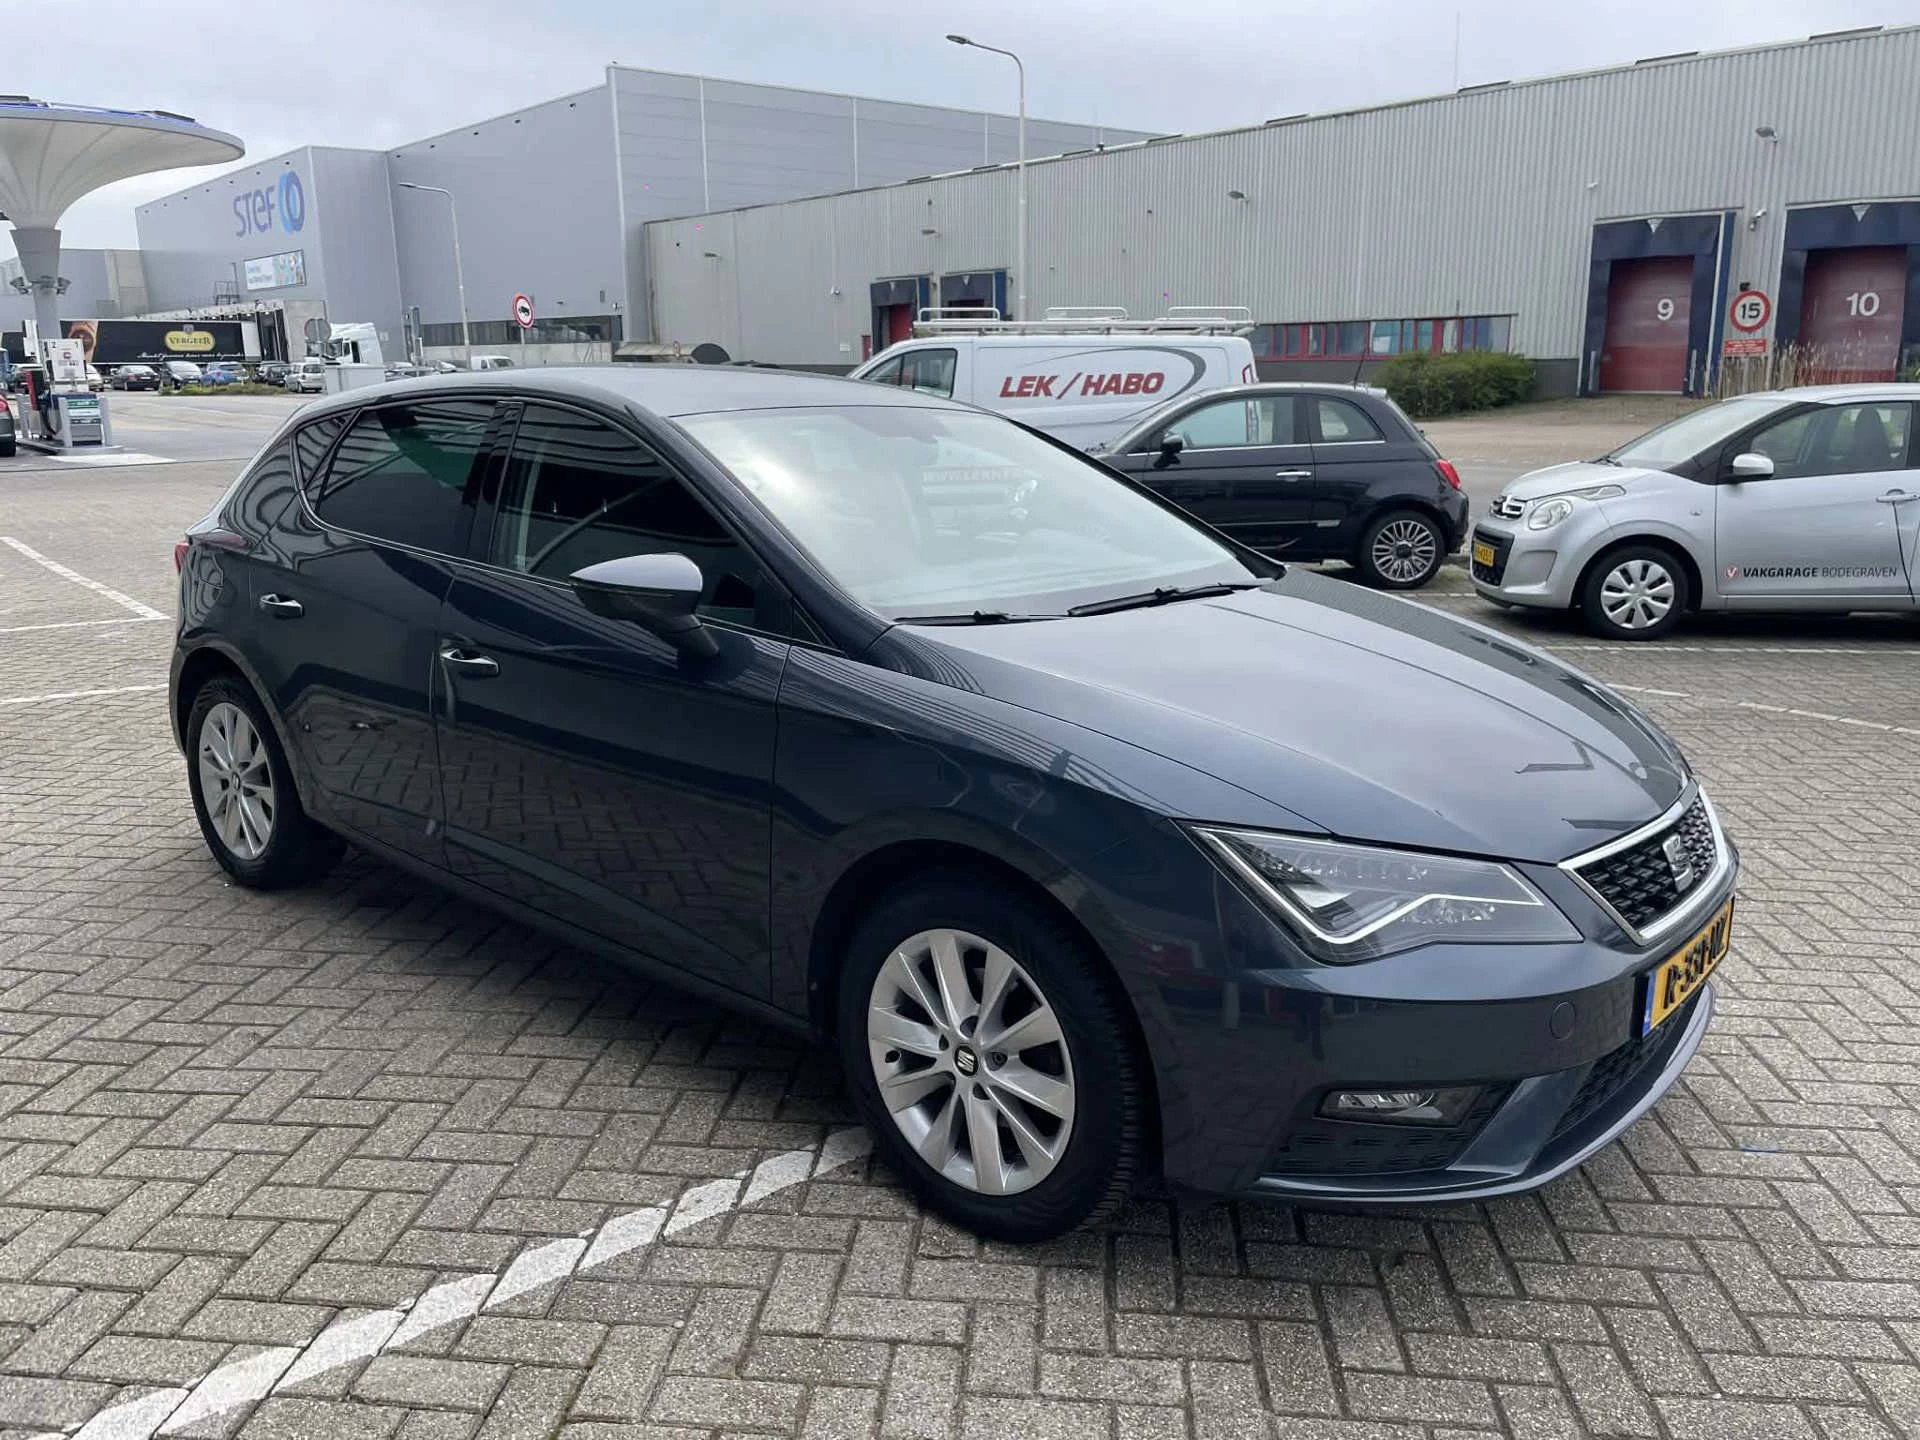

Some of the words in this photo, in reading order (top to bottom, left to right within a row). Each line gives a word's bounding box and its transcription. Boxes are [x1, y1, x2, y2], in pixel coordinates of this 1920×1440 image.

[1657, 298, 1674, 320] 9
[1740, 302, 1761, 320] 15
[1846, 292, 1880, 317] 10
[1743, 566, 1818, 578] VAKGARAGE
[1822, 566, 1897, 578] BODEGRAVEN
